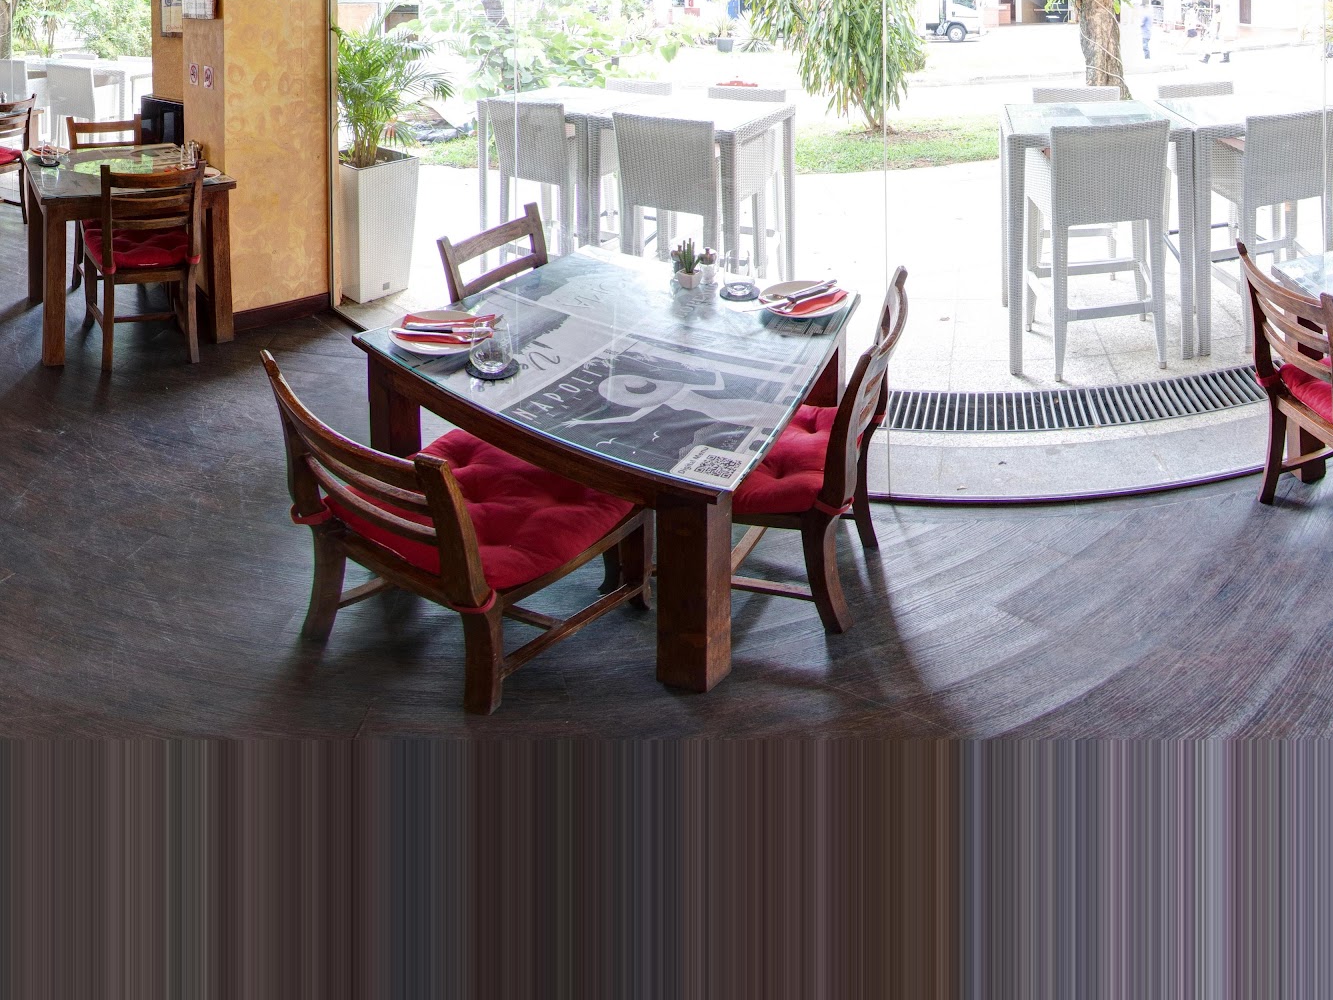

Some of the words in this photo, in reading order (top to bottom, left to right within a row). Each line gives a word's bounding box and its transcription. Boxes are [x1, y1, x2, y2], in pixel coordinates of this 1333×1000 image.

[511, 368, 603, 421] NAPOLI
[677, 458, 695, 474] Digital
[693, 446, 709, 461] Menu
